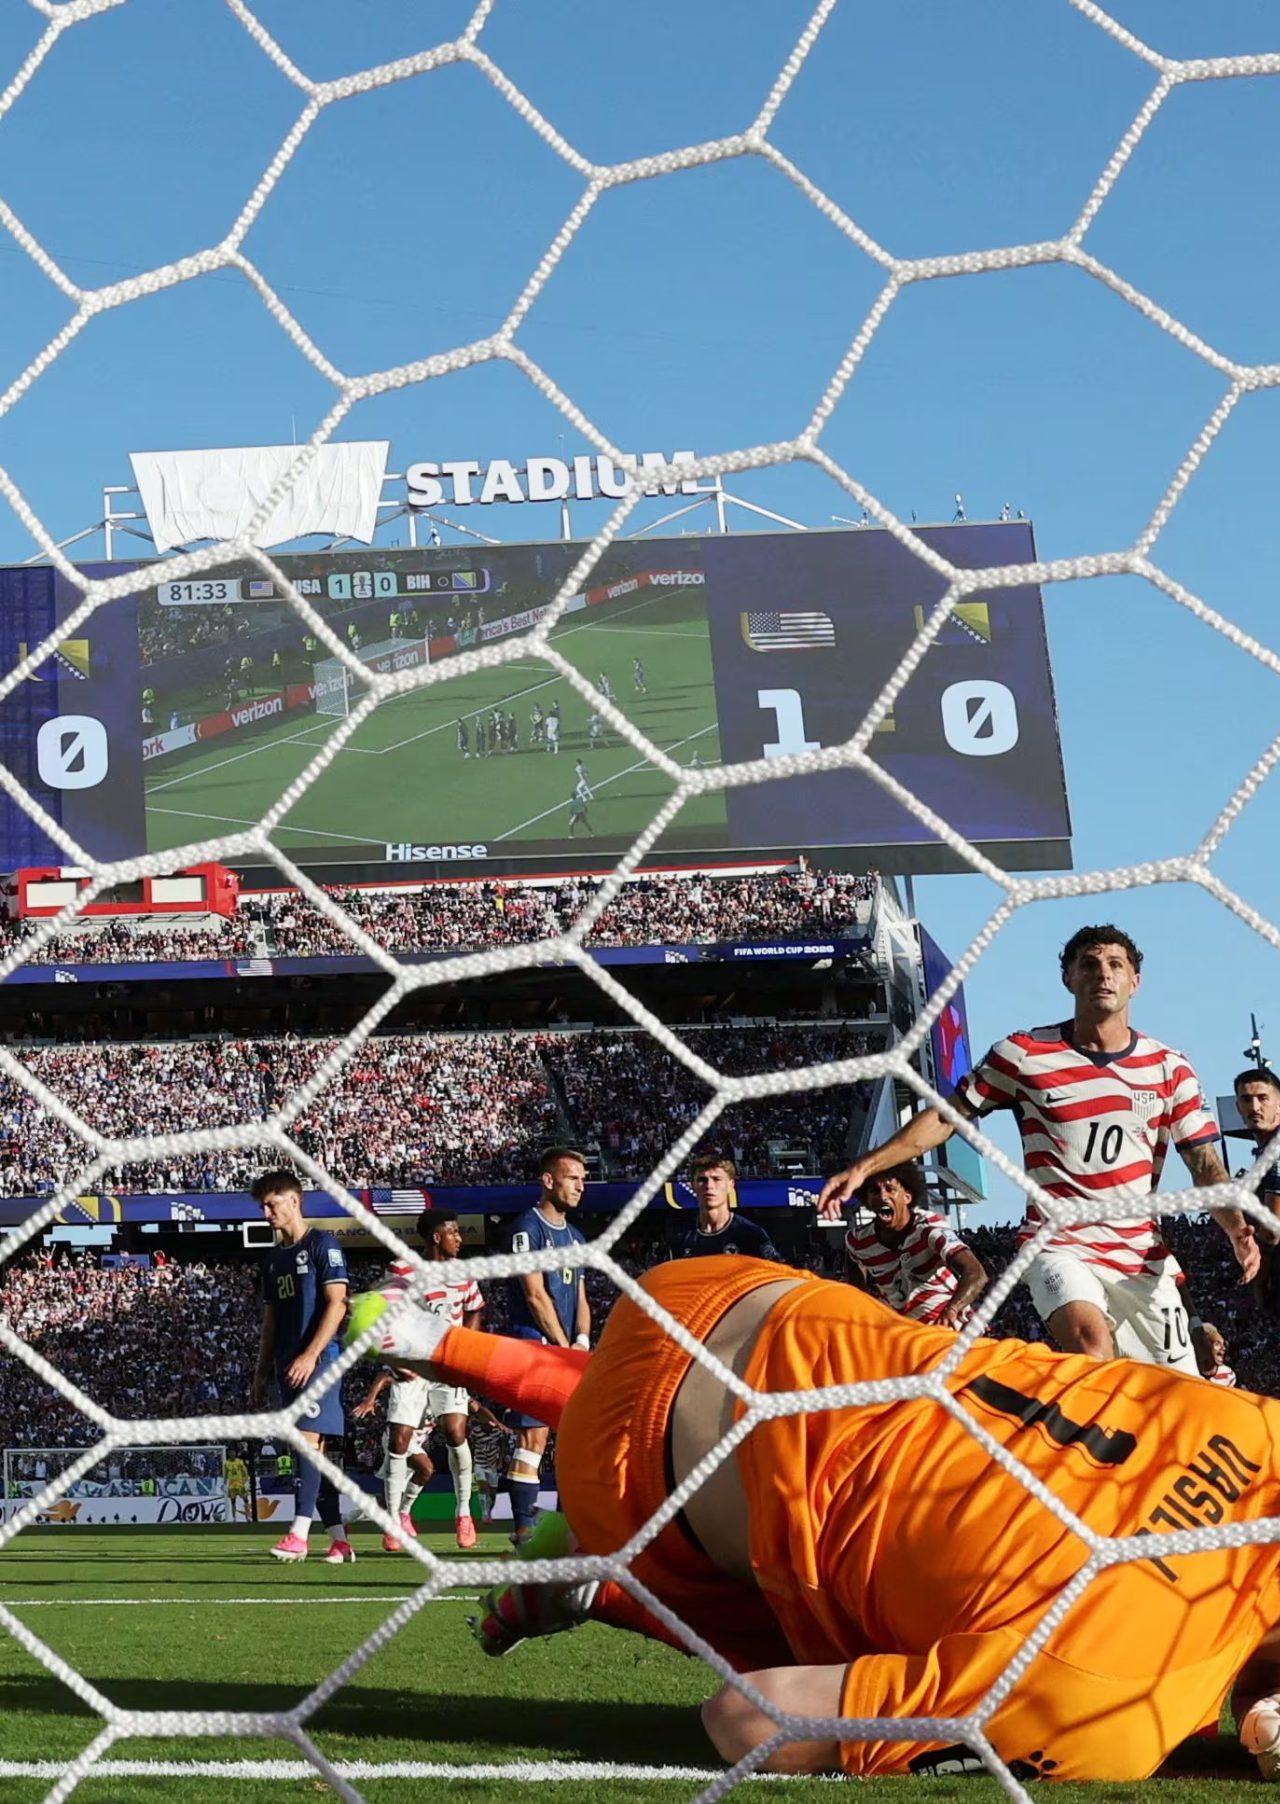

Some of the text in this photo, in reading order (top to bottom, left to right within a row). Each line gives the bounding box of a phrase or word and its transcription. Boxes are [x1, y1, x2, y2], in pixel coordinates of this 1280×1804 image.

[406, 451, 698, 506] STADIUM
[169, 582, 228, 602] 81:33
[334, 579, 344, 593] 1
[381, 577, 391, 591] 0
[406, 574, 431, 589] BIH
[607, 577, 639, 598] verizon
[231, 696, 283, 728] verizon
[757, 688, 822, 760] 1
[941, 680, 1019, 756] 0
[36, 715, 109, 789] 0
[385, 843, 488, 861] Hisense
[734, 948, 753, 956] FIFA
[754, 946, 785, 956] WORLD
[786, 946, 803, 955] CUP
[1133, 1092, 1155, 1105] USA
[1083, 1121, 1124, 1165] 10
[277, 1274, 295, 1299] 20
[1160, 1306, 1187, 1350] 10
[157, 1496, 227, 1523] Dove
